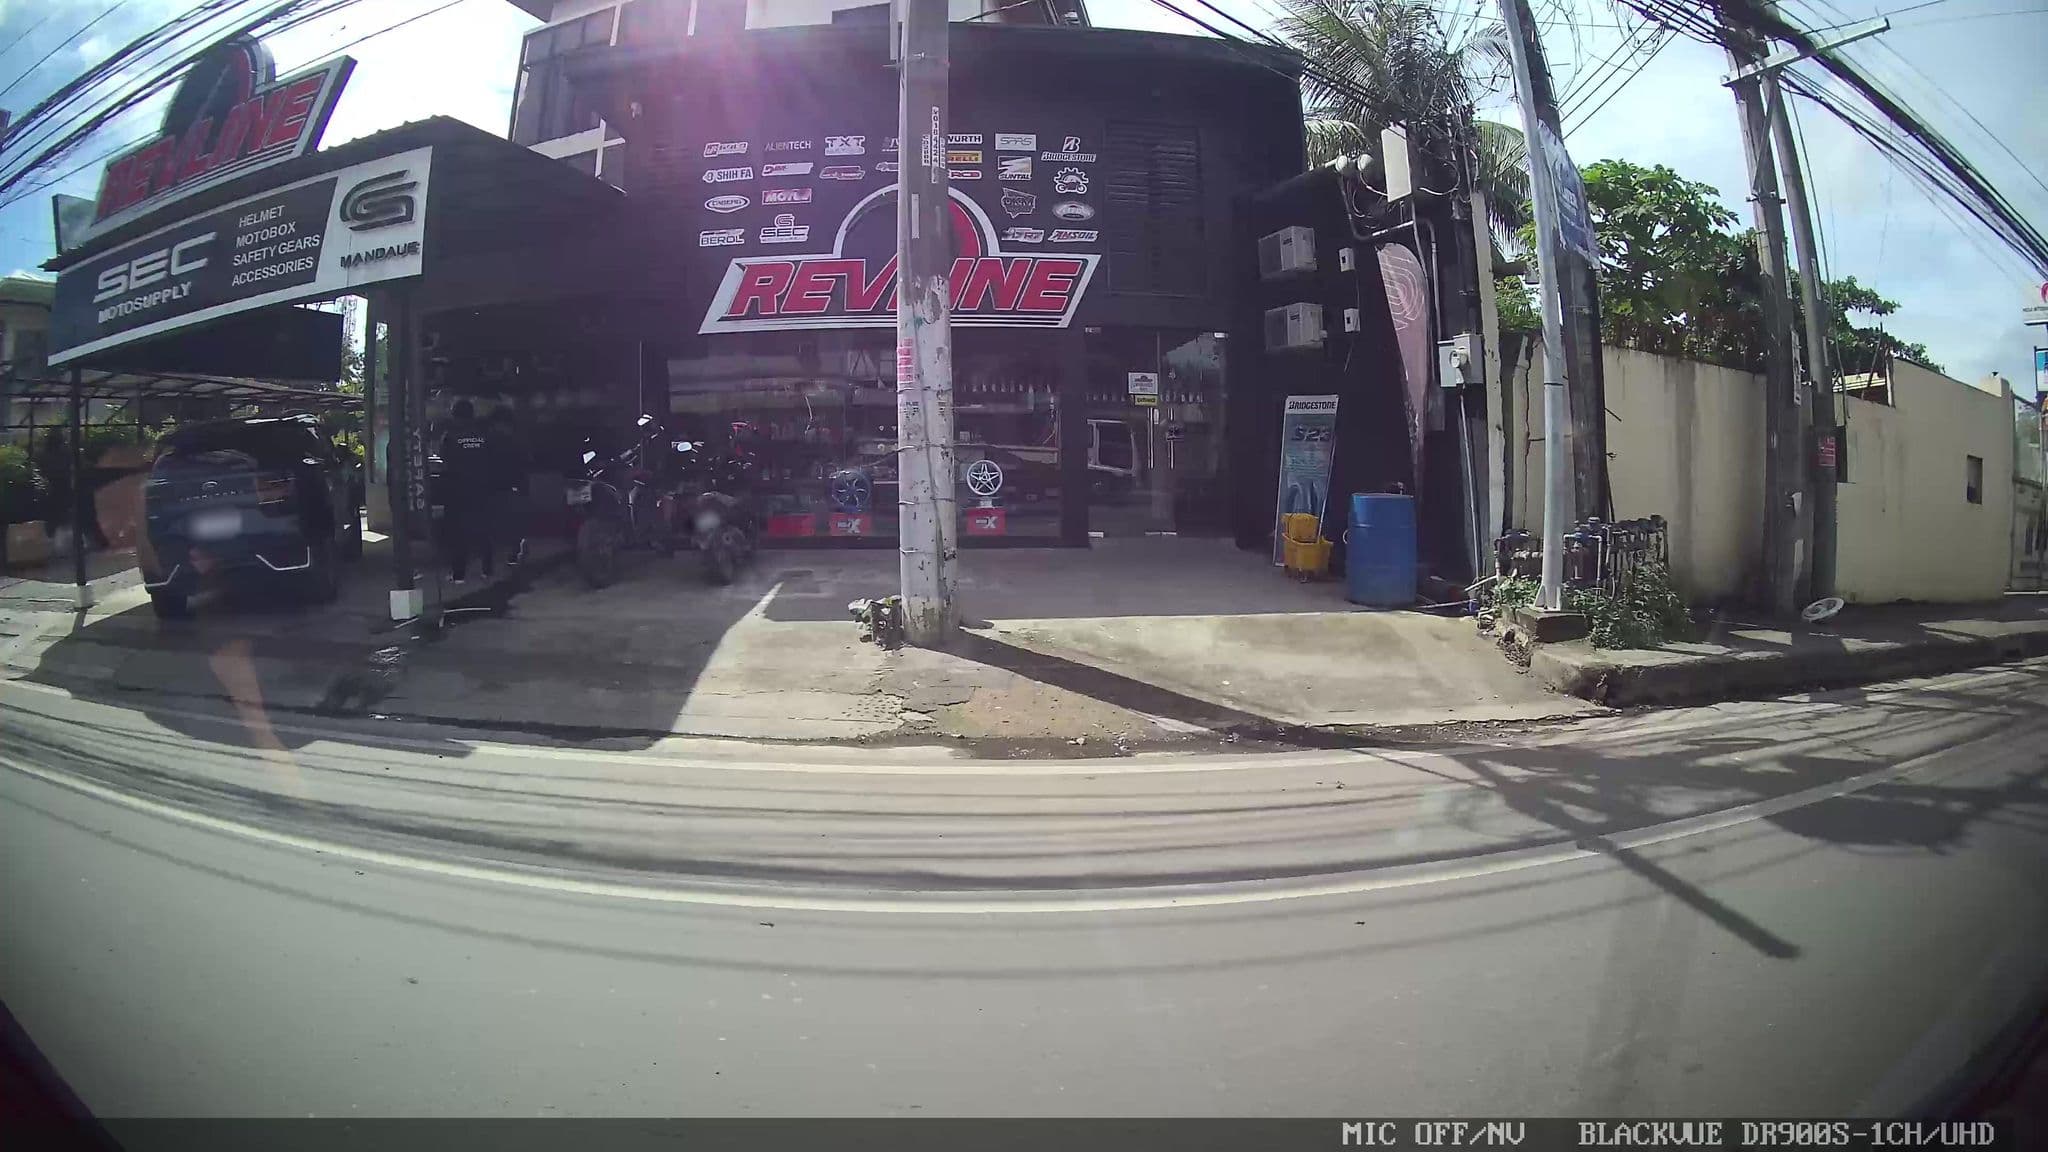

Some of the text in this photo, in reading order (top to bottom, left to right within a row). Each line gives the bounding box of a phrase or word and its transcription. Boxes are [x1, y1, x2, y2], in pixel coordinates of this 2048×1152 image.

[765, 141, 812, 151] ALIENTECH
[717, 169, 752, 181] SHIH FA
[239, 205, 286, 228] HELMET
[236, 222, 296, 248] MOTOBOX
[761, 226, 809, 238] SEC
[233, 234, 321, 267] SAFETY GEARS
[340, 241, 421, 269] MANDAUE
[93, 231, 218, 303] SEC
[232, 256, 314, 287] ACCESSORIES
[726, 257, 1084, 316] REVINE
[98, 281, 192, 323] MOTOSUPPLY
[1288, 401, 1336, 410] BRIDGESTONE
